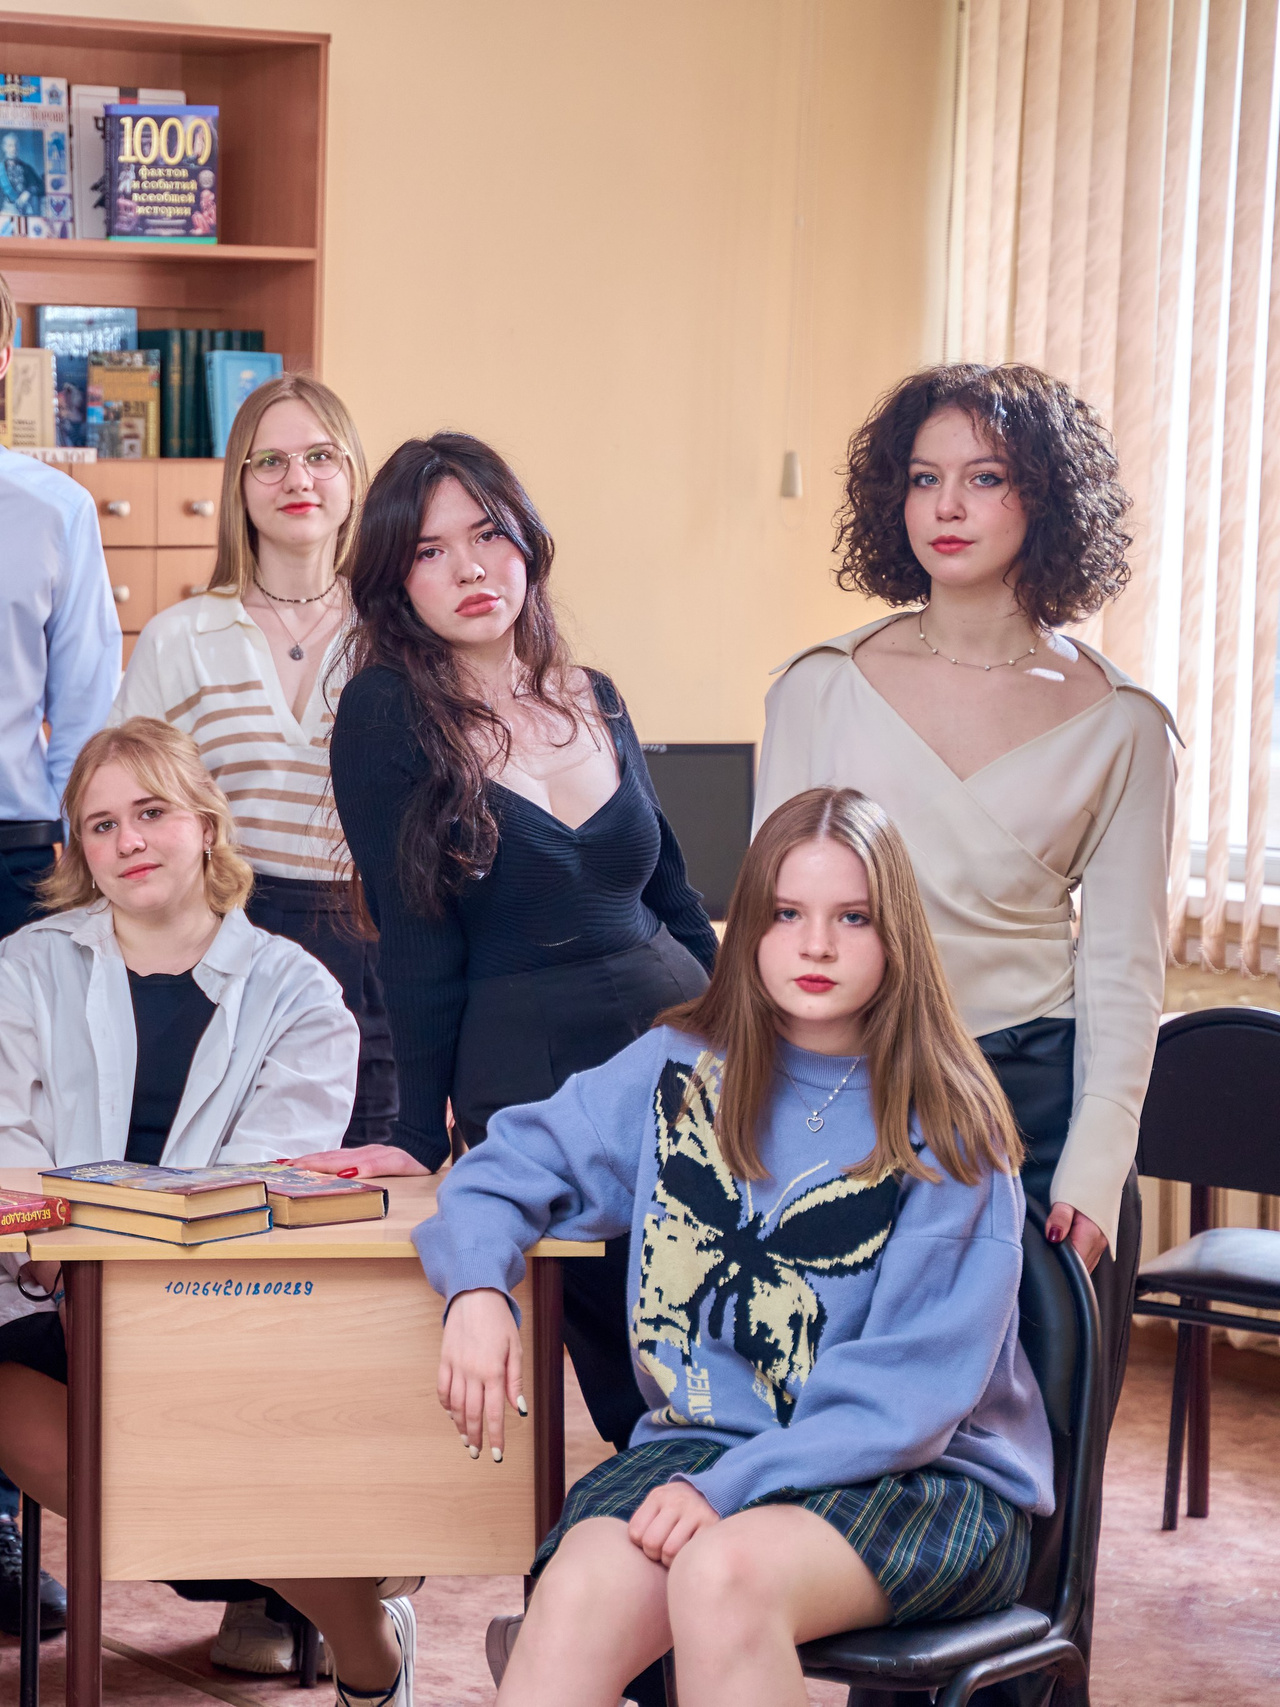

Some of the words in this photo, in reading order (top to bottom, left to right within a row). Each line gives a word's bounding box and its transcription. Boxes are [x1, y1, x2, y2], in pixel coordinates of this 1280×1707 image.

[118, 116, 212, 165] 1000
[138, 165, 188, 180] фактов
[141, 179, 197, 191] событий
[132, 192, 196, 204] всеобщей
[136, 205, 192, 217] истории
[0, 1208, 51, 1226] БЕЛЬФЕДДОР
[165, 1279, 314, 1296] 101264201800289
